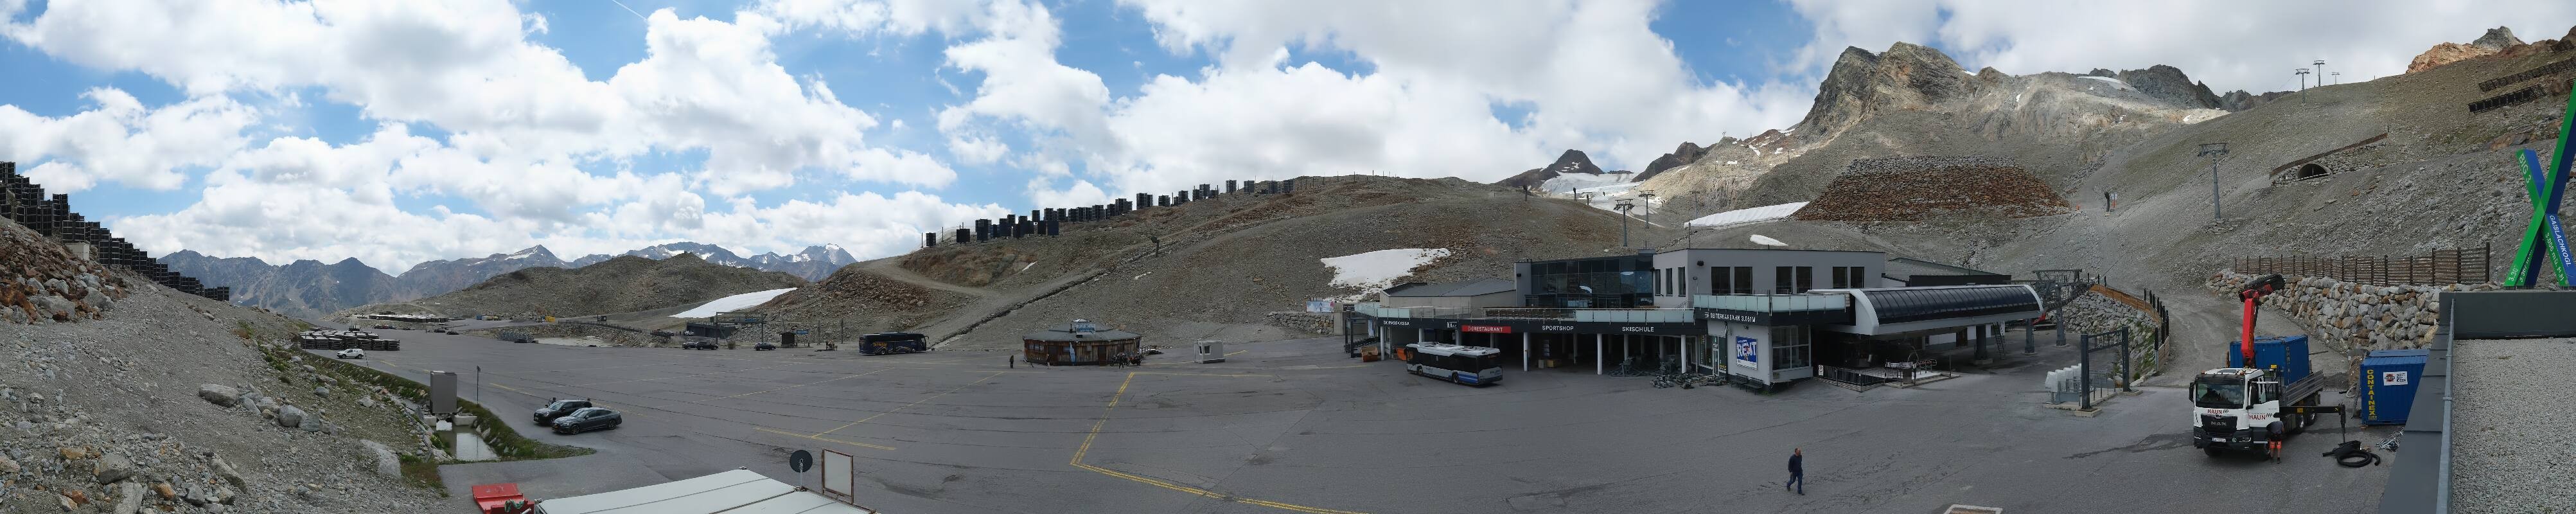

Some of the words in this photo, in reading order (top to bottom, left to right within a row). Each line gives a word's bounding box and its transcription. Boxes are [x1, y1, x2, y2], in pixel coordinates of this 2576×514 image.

[2519, 153, 2528, 175] BIG
[2526, 174, 2532, 184] 3
[2549, 215, 2572, 267] GAISLACHKOGL
[2367, 369, 2376, 416] CONTAINEX
